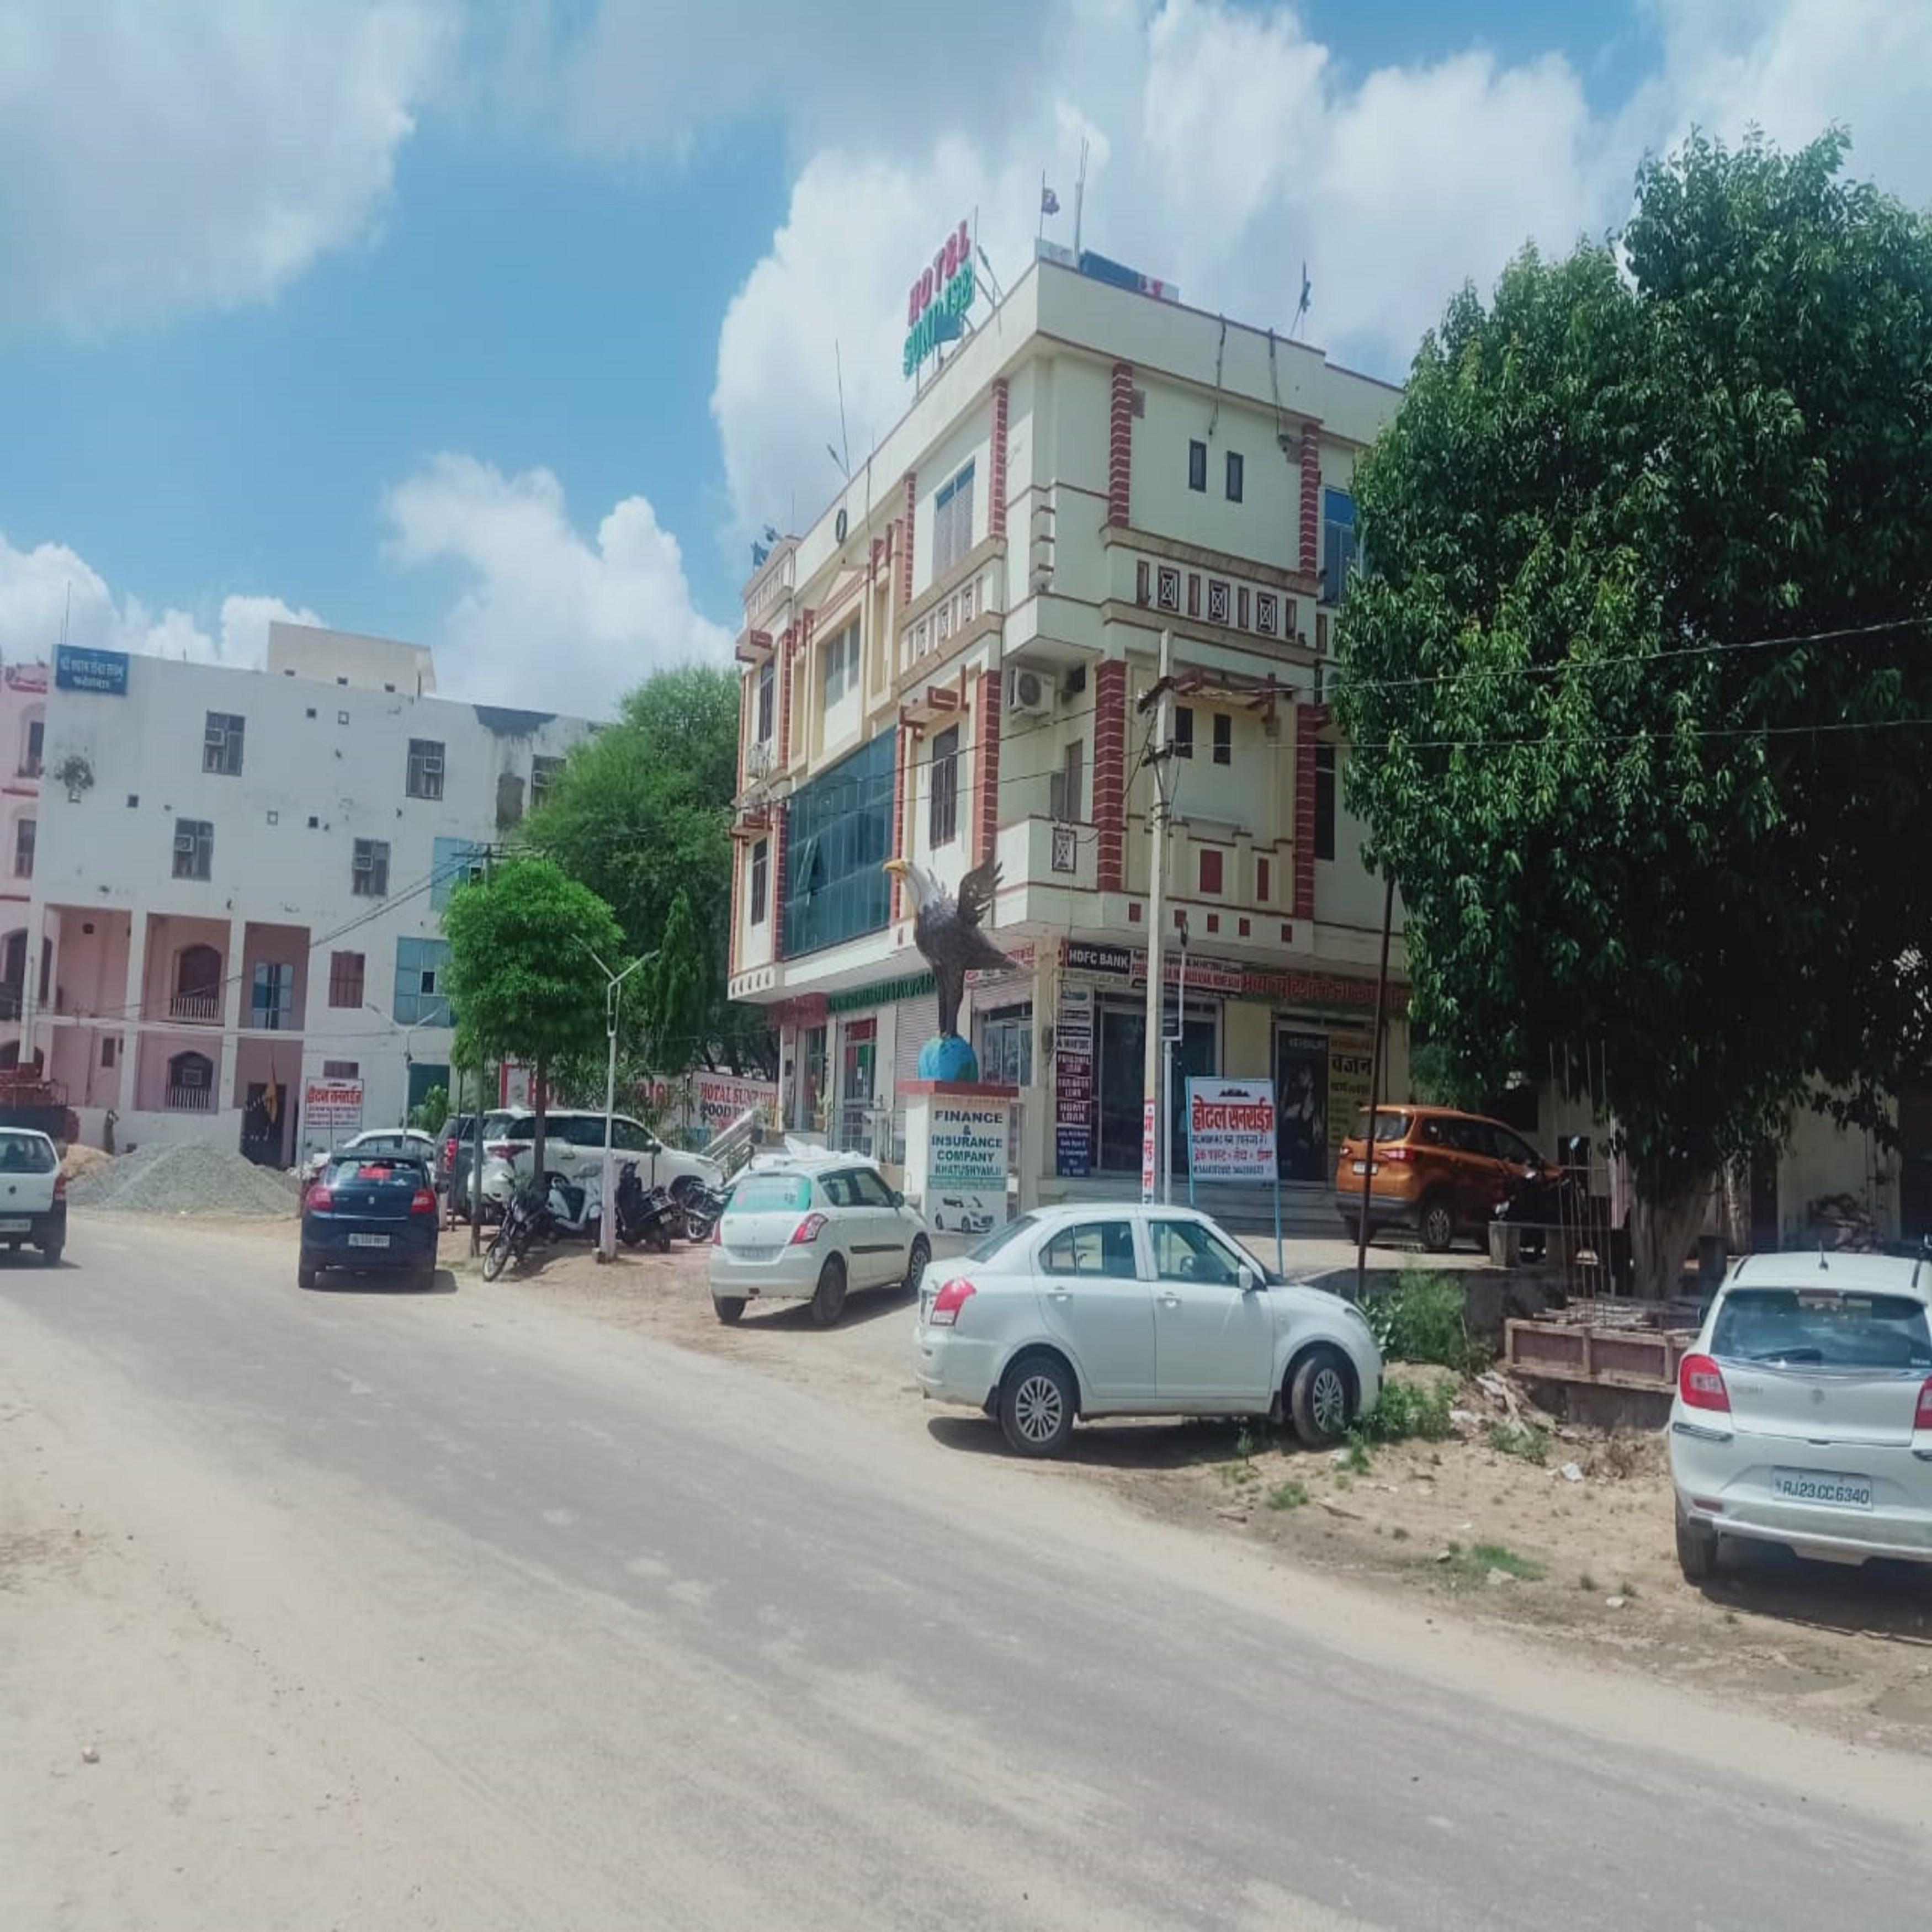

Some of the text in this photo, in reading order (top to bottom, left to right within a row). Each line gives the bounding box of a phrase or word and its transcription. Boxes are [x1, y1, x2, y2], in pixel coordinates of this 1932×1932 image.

[908, 220, 971, 326] HOTEL
[1069, 949, 1097, 965] HDFC
[1099, 953, 1129, 969] BANK
[935, 1110, 1003, 1123] FINANCE
[1061, 1112, 1085, 1122] LOAN
[1192, 1095, 1227, 1132] होटल
[963, 1125, 972, 1135] &
[932, 1135, 1003, 1148] INSURANCE
[937, 1150, 995, 1163] COMPANY
